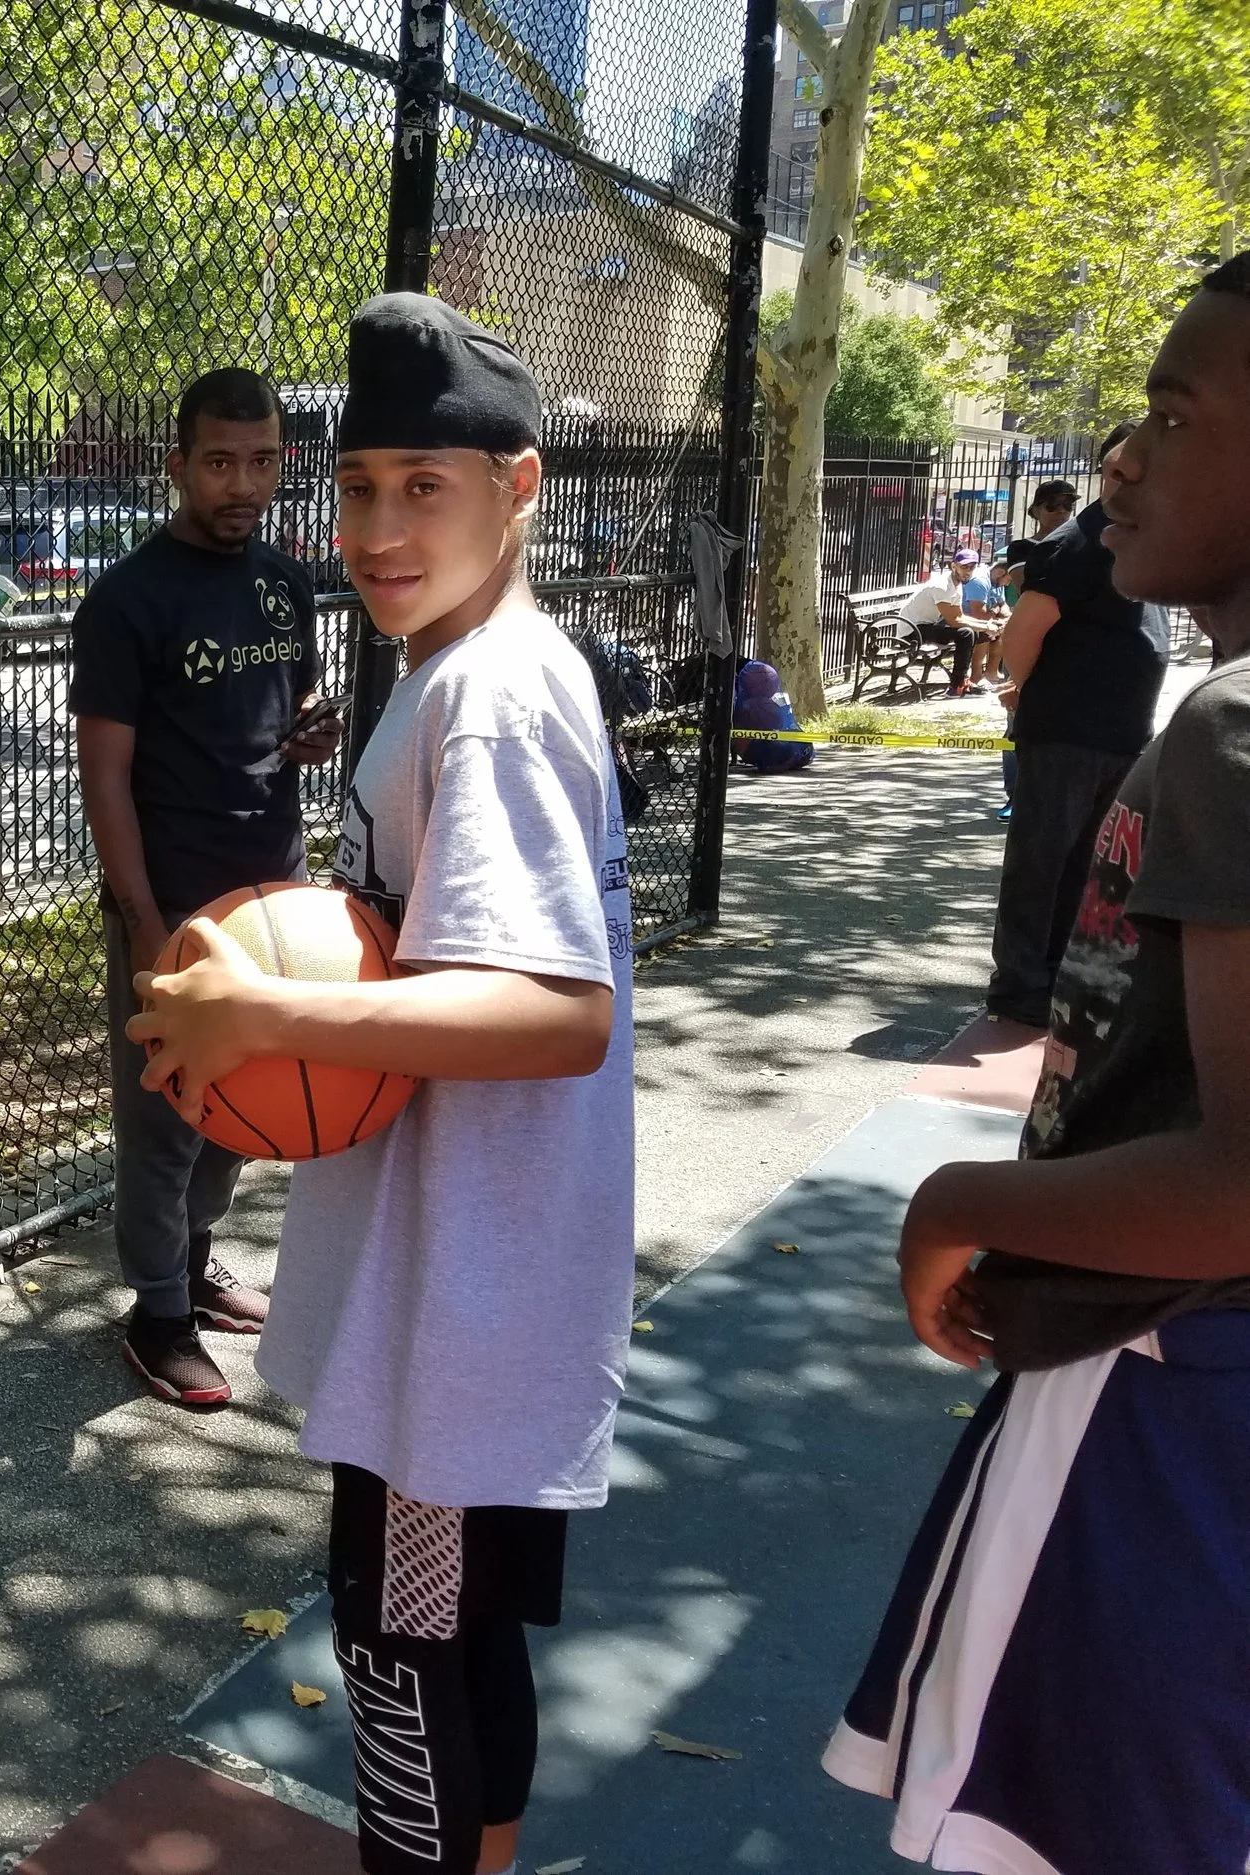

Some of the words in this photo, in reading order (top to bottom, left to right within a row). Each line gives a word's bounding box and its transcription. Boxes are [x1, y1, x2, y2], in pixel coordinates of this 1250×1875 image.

[231, 635, 302, 672] gradelo
[829, 734, 884, 745] CAUTION
[937, 738, 995, 749] CAUTION
